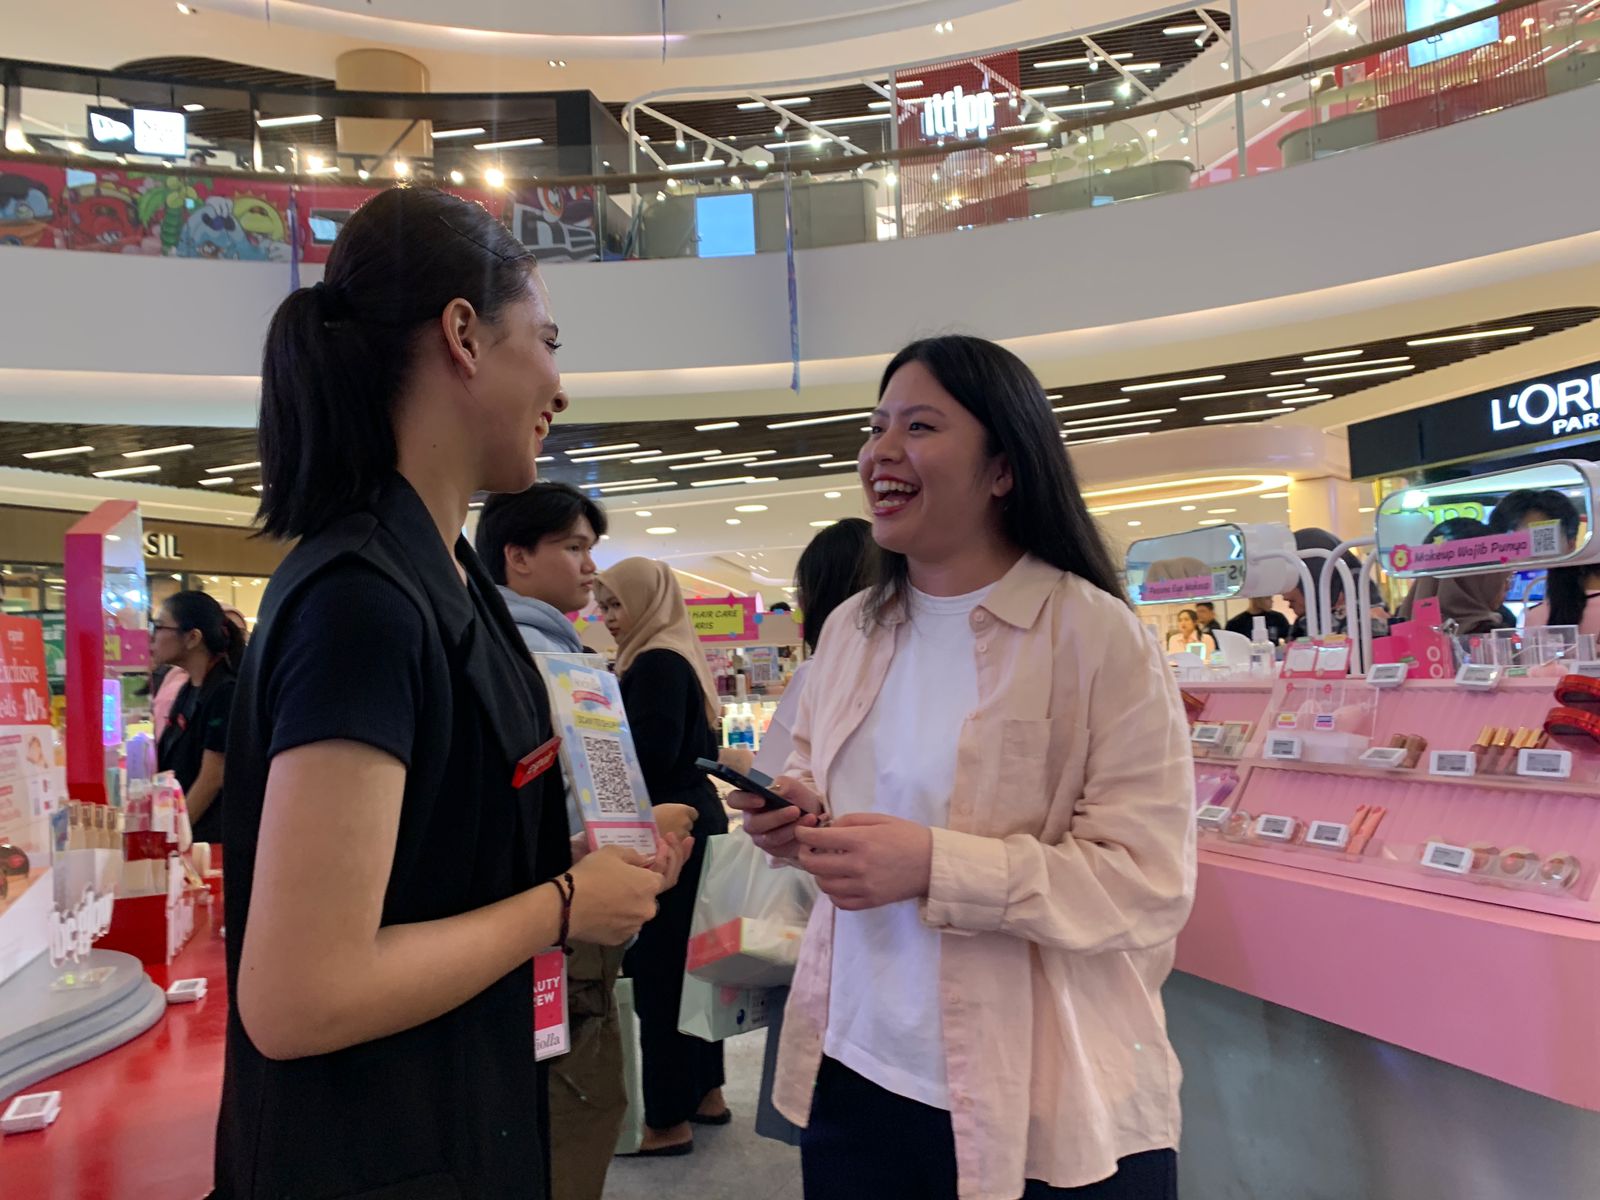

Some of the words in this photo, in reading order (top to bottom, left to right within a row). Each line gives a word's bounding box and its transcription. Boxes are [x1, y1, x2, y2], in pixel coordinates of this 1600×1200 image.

[1414, 548, 1455, 562] Makeup
[1457, 542, 1488, 559] Wajib
[1491, 541, 1528, 555] Punya
[692, 610, 713, 618] HAIR
[715, 610, 737, 618] CARE
